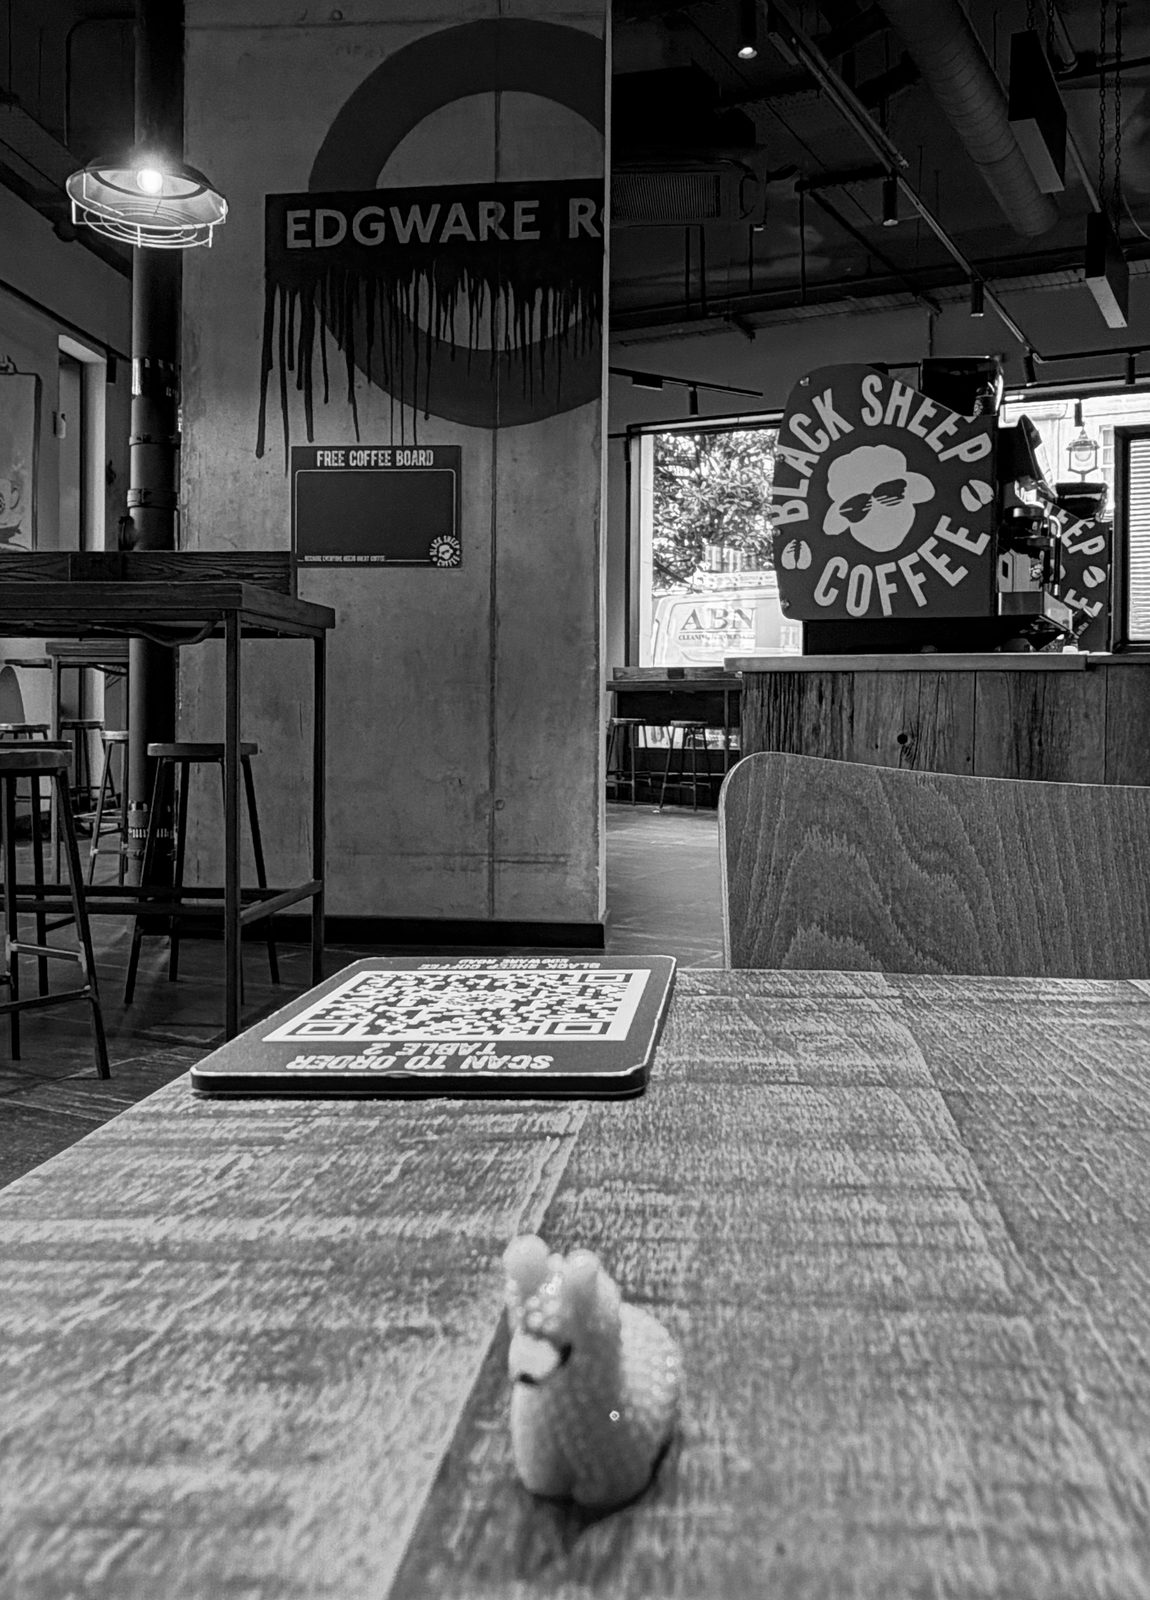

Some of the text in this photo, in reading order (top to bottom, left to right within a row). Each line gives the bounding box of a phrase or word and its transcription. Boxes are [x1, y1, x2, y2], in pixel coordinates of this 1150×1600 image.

[286, 198, 605, 249] EDGWARE R
[316, 449, 434, 467] FREE COFFEE BOARD
[770, 374, 993, 526] BLACK SHEEP
[813, 514, 992, 617] COFFEE
[680, 607, 756, 631] ABN
[363, 1042, 496, 1056] TABLE 2
[286, 1054, 554, 1070] SCAN TO ORDER
